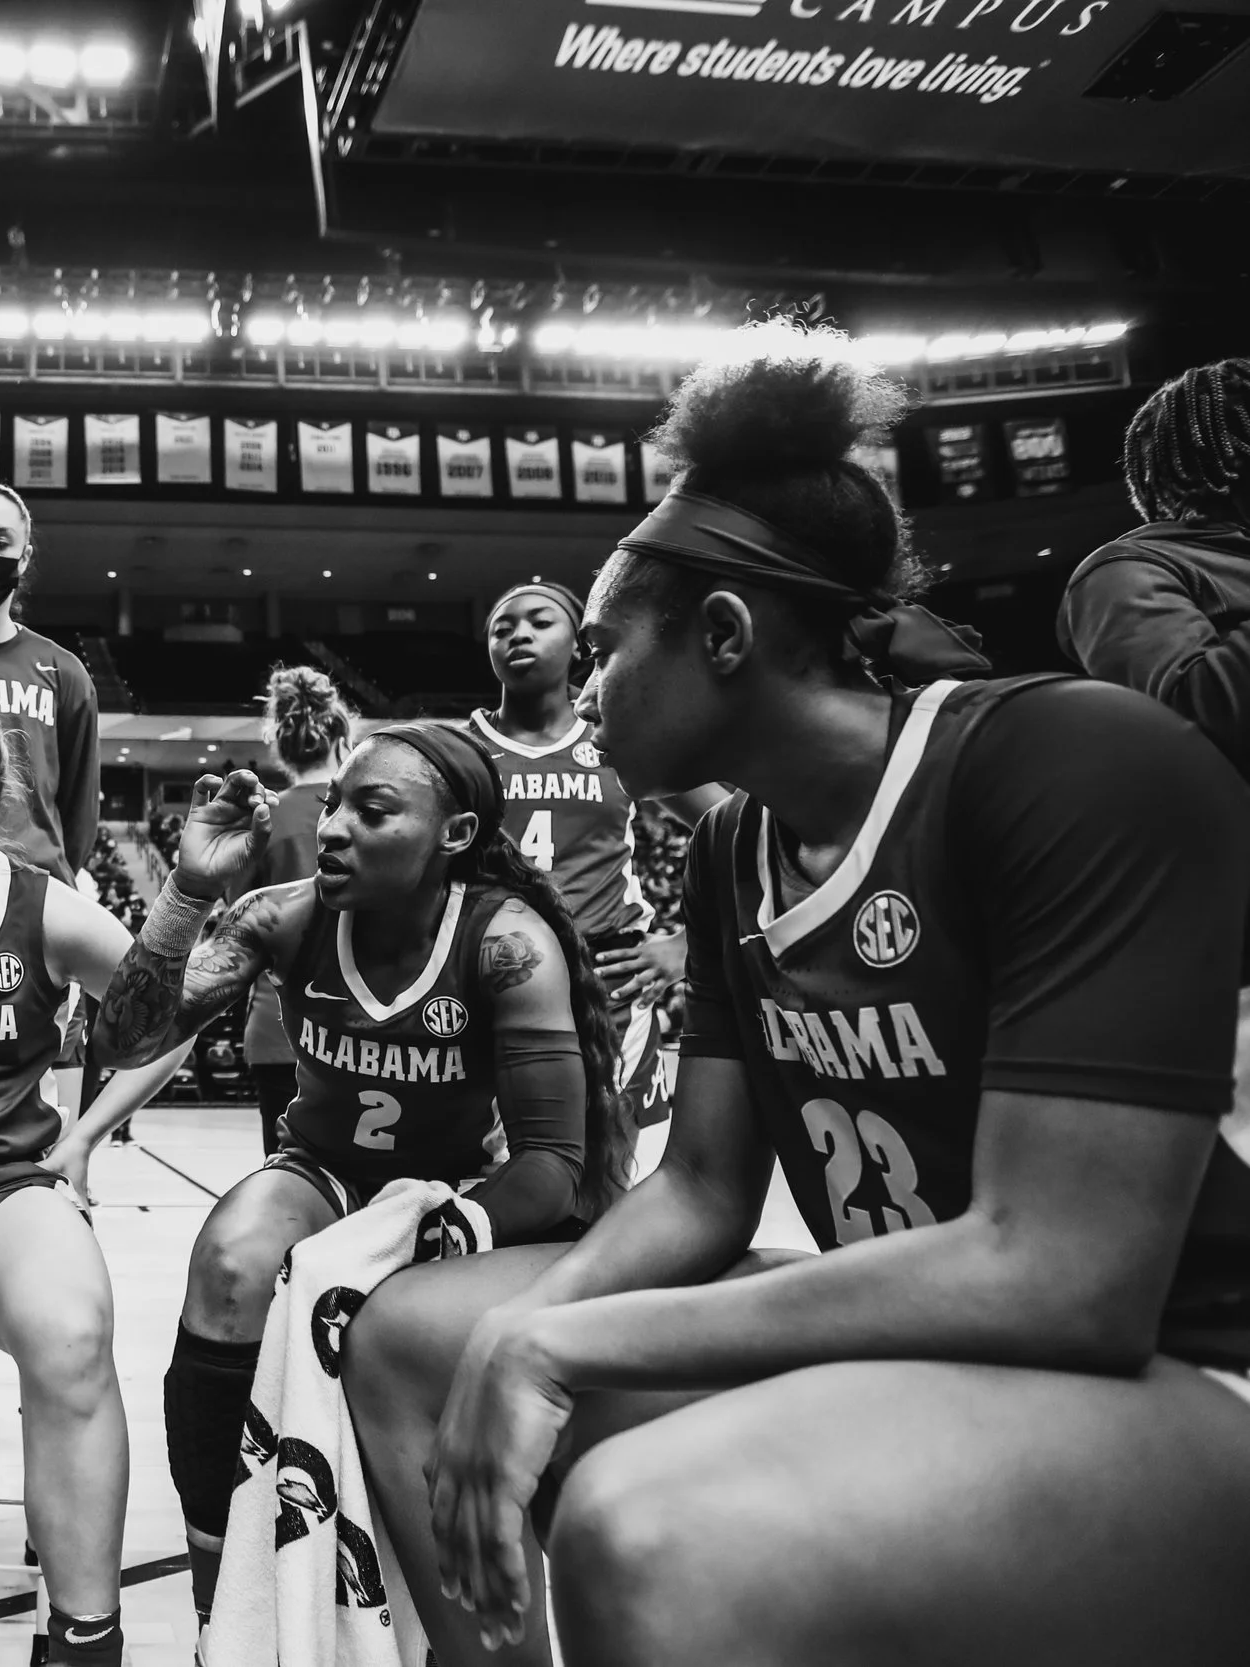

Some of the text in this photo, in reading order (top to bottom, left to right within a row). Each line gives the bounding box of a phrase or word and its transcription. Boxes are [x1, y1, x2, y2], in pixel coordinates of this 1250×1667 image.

[554, 22, 1031, 104] Where students love living.
[520, 810, 555, 872] 4
[859, 896, 914, 962] SEC
[300, 1017, 466, 1083] ALABAMA
[427, 1000, 465, 1034] SEC
[353, 1090, 402, 1150] 2
[801, 1098, 938, 1246] 23
